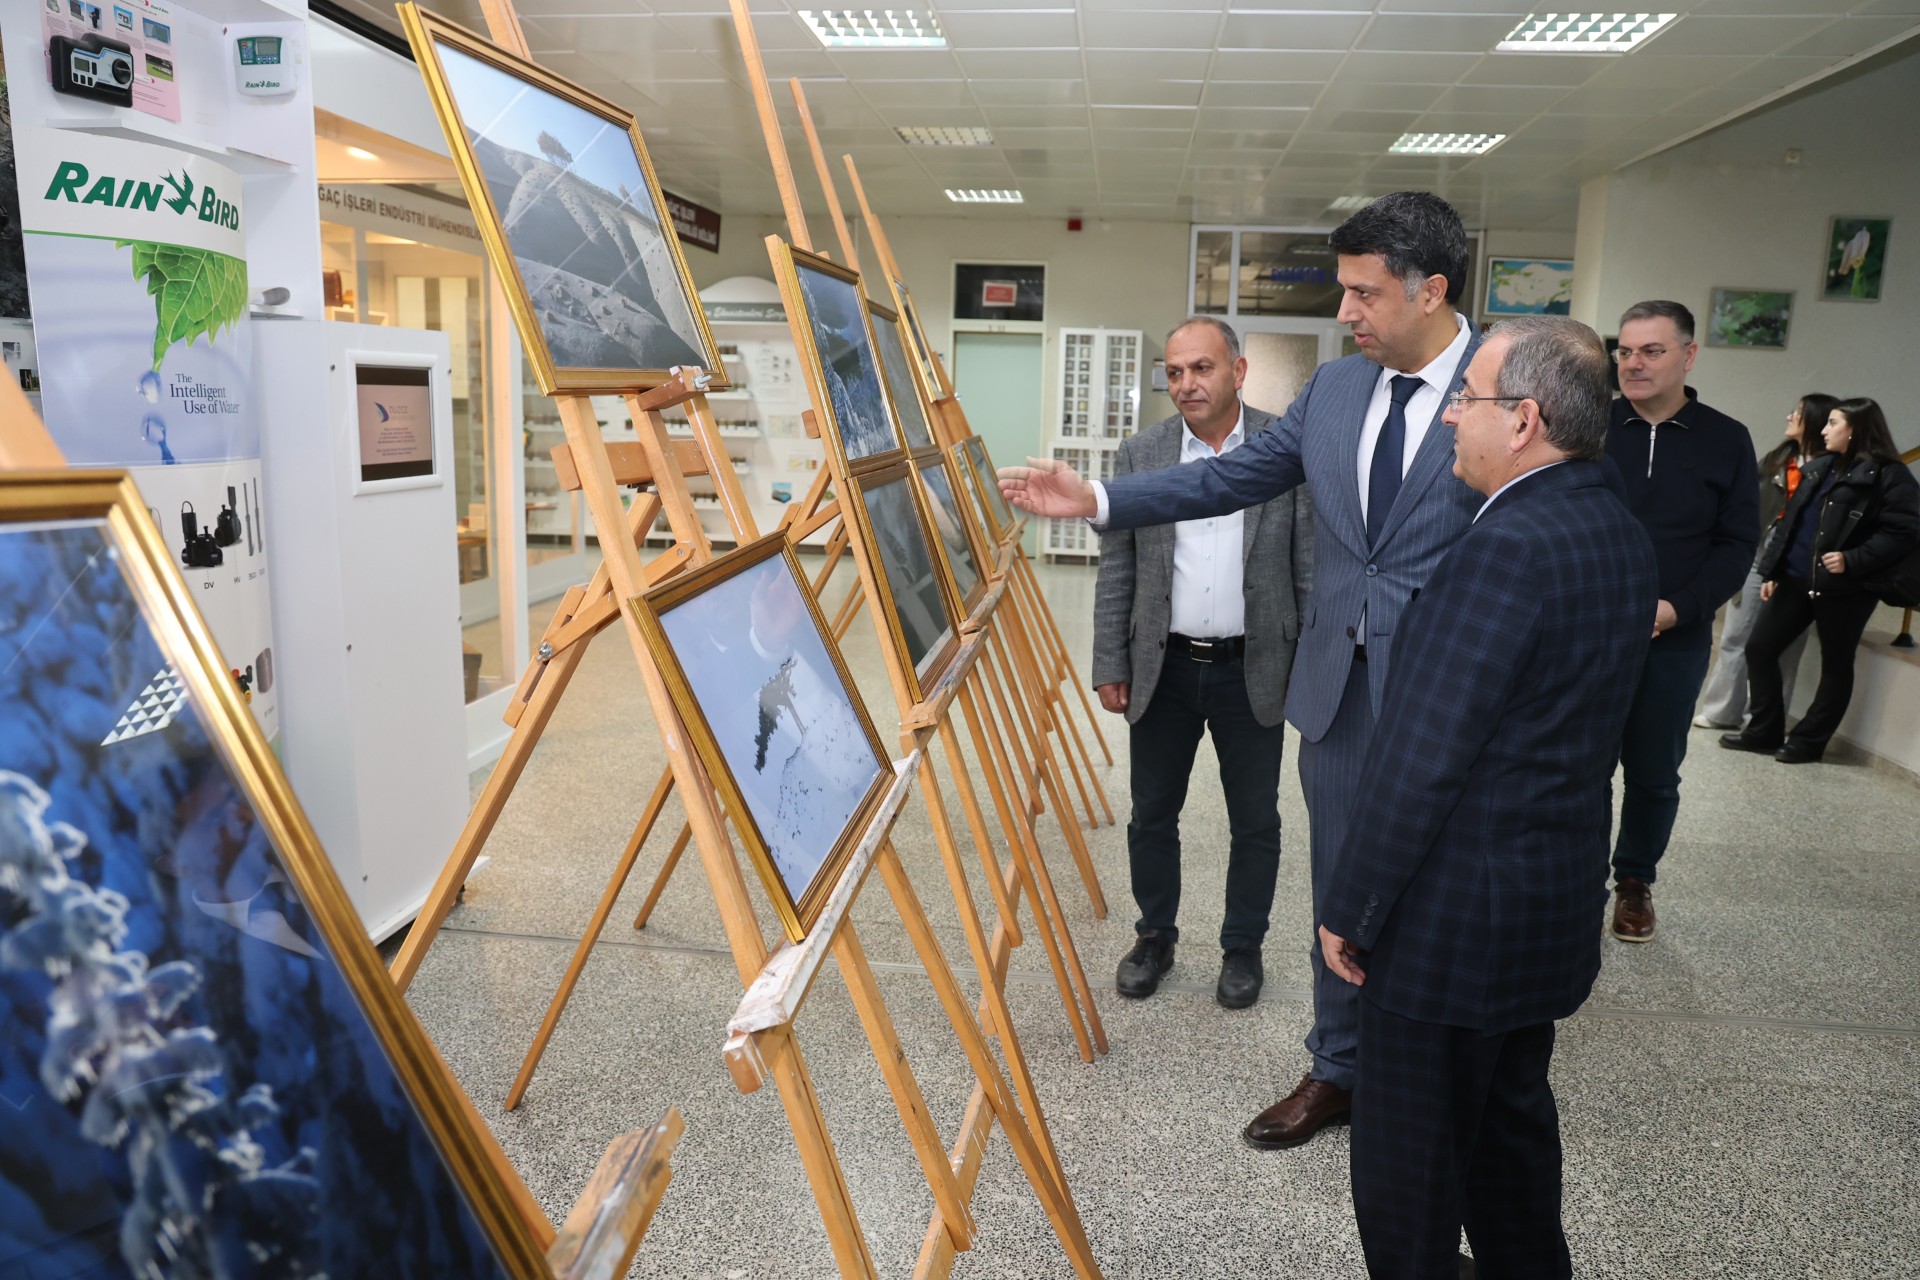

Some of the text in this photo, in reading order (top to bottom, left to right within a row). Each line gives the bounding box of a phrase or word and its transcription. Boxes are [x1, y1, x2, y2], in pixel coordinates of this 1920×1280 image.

[44, 161, 239, 231] RAIN BIRD
[318, 184, 340, 208] ĞAÇ
[343, 189, 376, 213] İŞLERİ
[379, 202, 426, 226] ENDÜSTRİ
[176, 373, 192, 383] The
[170, 383, 226, 401] Intelligent
[184, 400, 240, 414] Use of Water
[204, 581, 214, 589] DV
